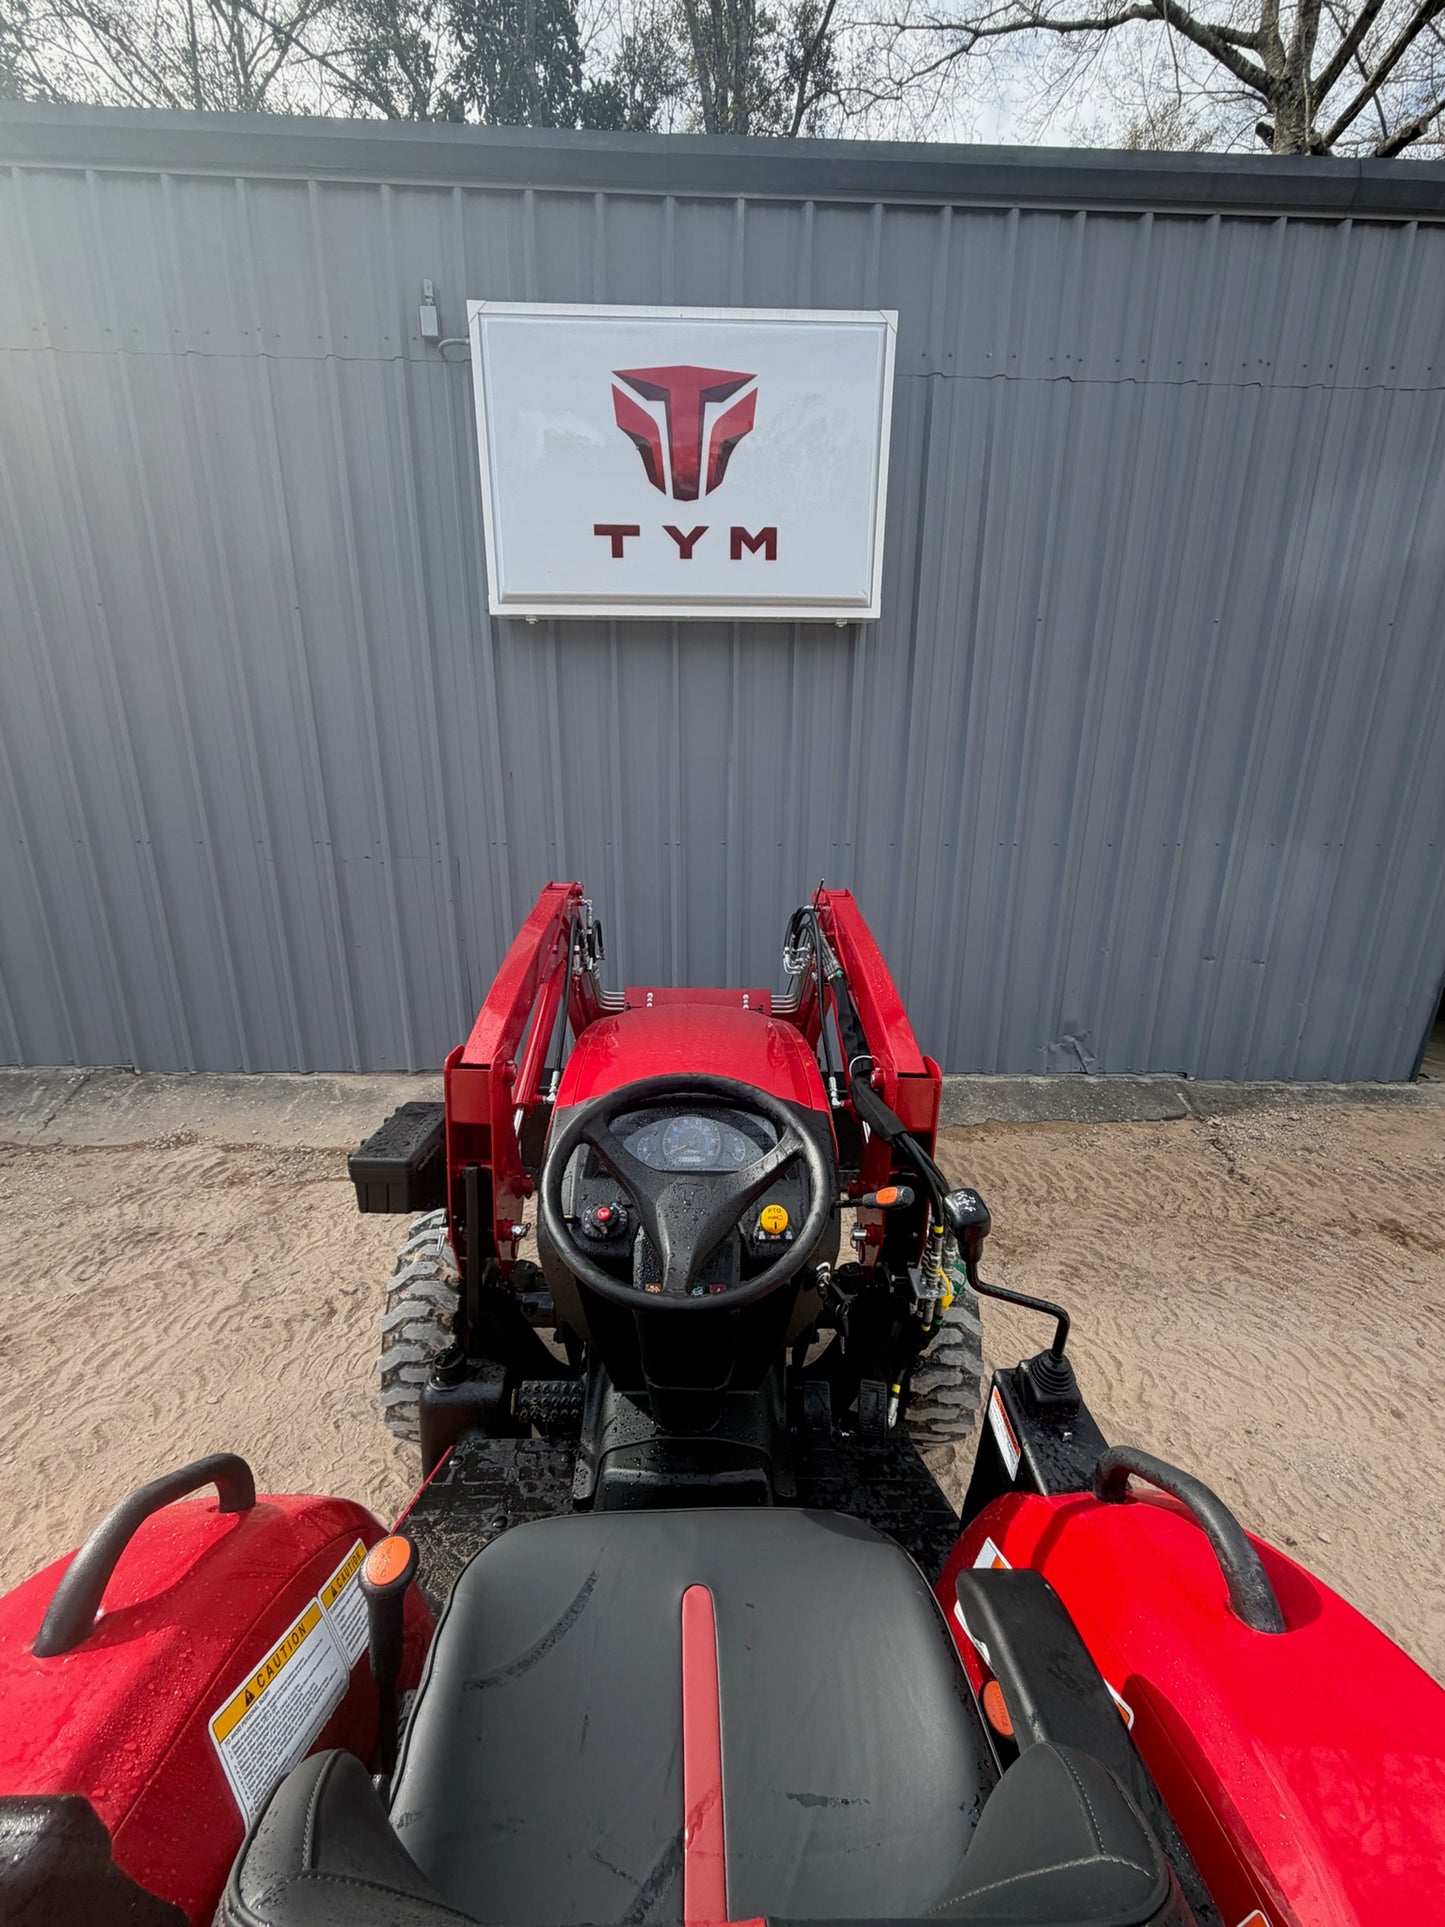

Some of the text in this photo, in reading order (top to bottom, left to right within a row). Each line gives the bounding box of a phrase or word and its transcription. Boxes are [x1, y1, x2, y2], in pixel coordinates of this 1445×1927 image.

[594, 524, 777, 560] TYM
[336, 1551, 361, 1588] CAUTION
[256, 1623, 307, 1688] CAUTION
